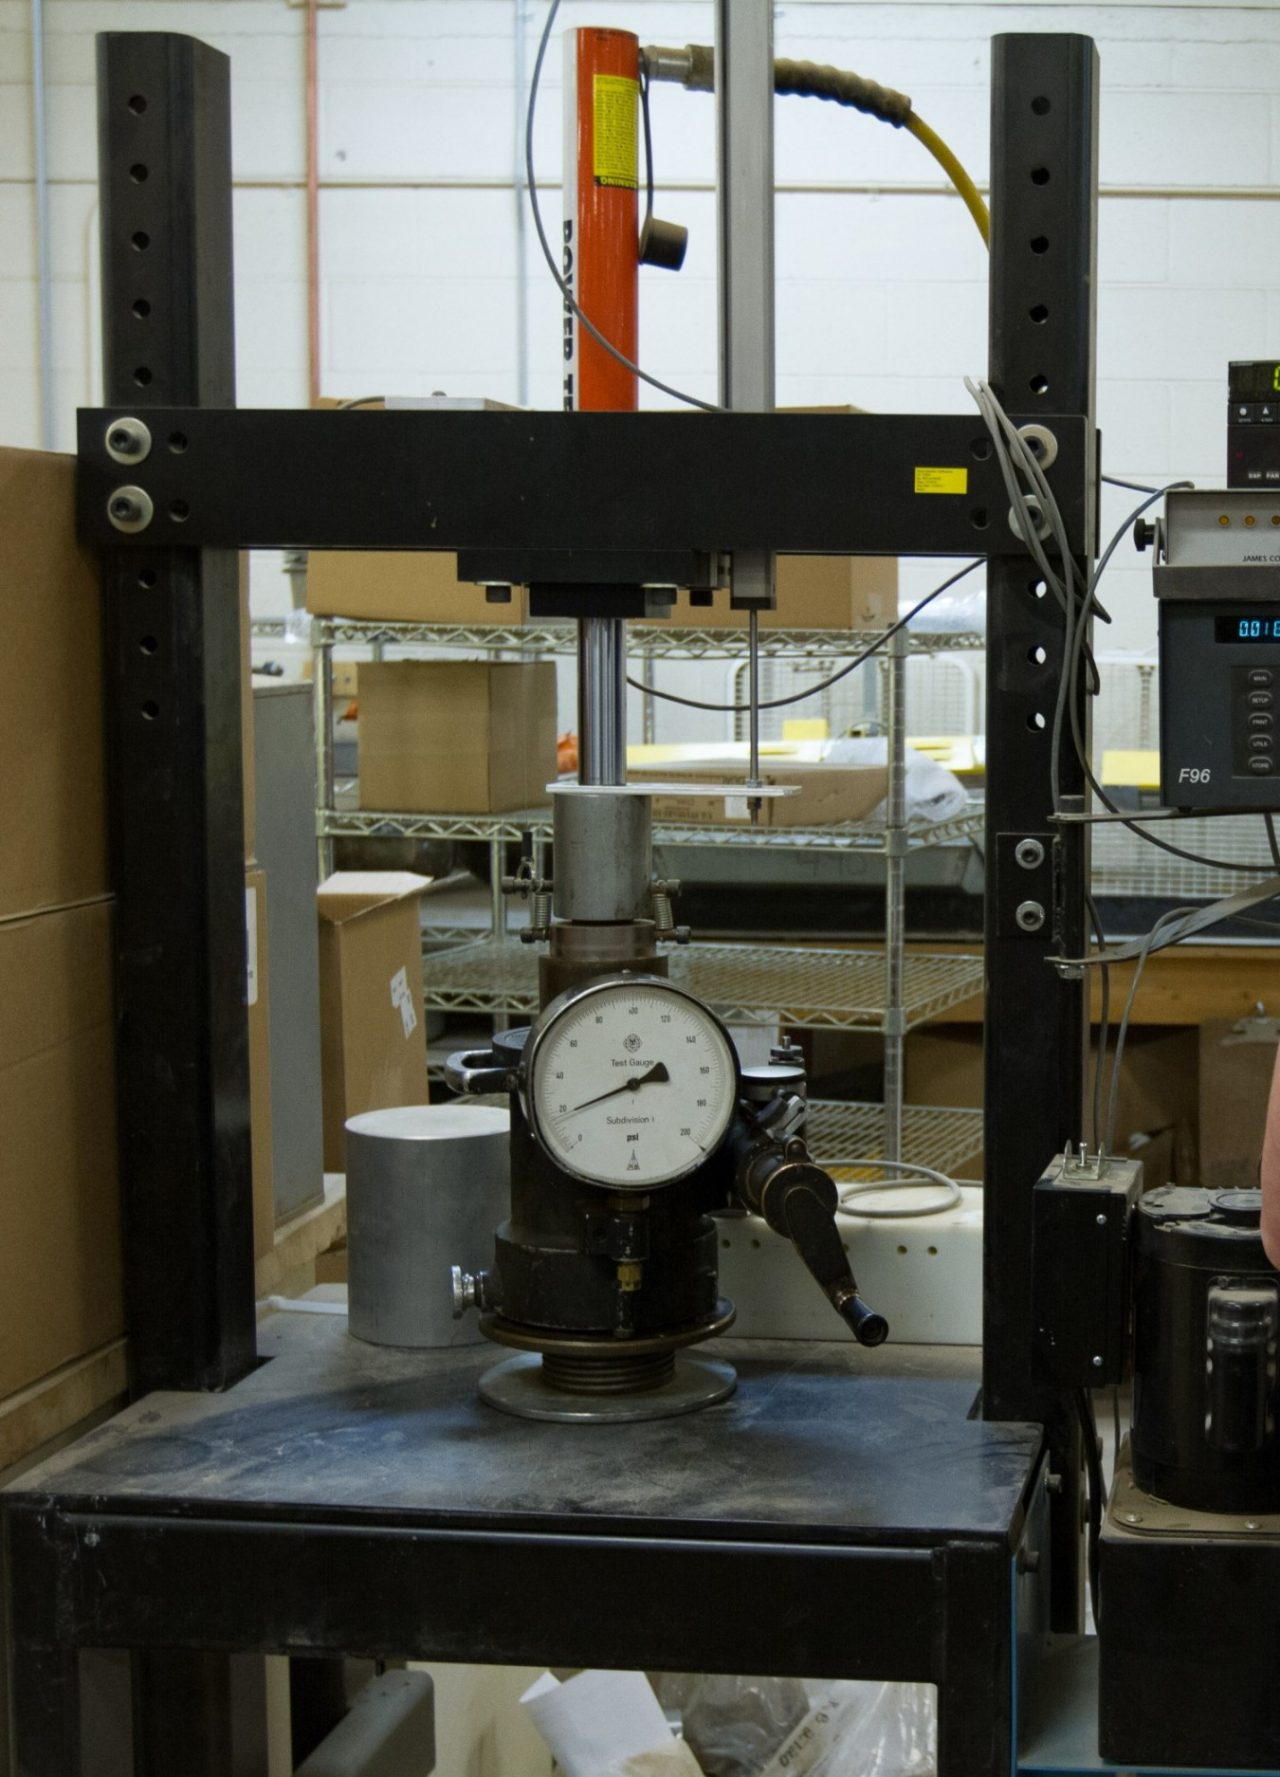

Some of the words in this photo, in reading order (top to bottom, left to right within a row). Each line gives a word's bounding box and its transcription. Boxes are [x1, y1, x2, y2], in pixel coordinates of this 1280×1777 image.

[1179, 768, 1211, 784] F96
[660, 1015, 671, 1024] 120
[611, 1058, 627, 1067] Test
[629, 1058, 654, 1068] Gauge
[556, 1071, 563, 1080] 40
[700, 1067, 709, 1075] 160
[697, 1098, 706, 1107] 180
[559, 1104, 567, 1113] 20
[606, 1116, 649, 1125] Subdivision
[680, 1127, 691, 1136] 200
[578, 1133, 582, 1142] 0
[626, 1133, 639, 1142] psi
